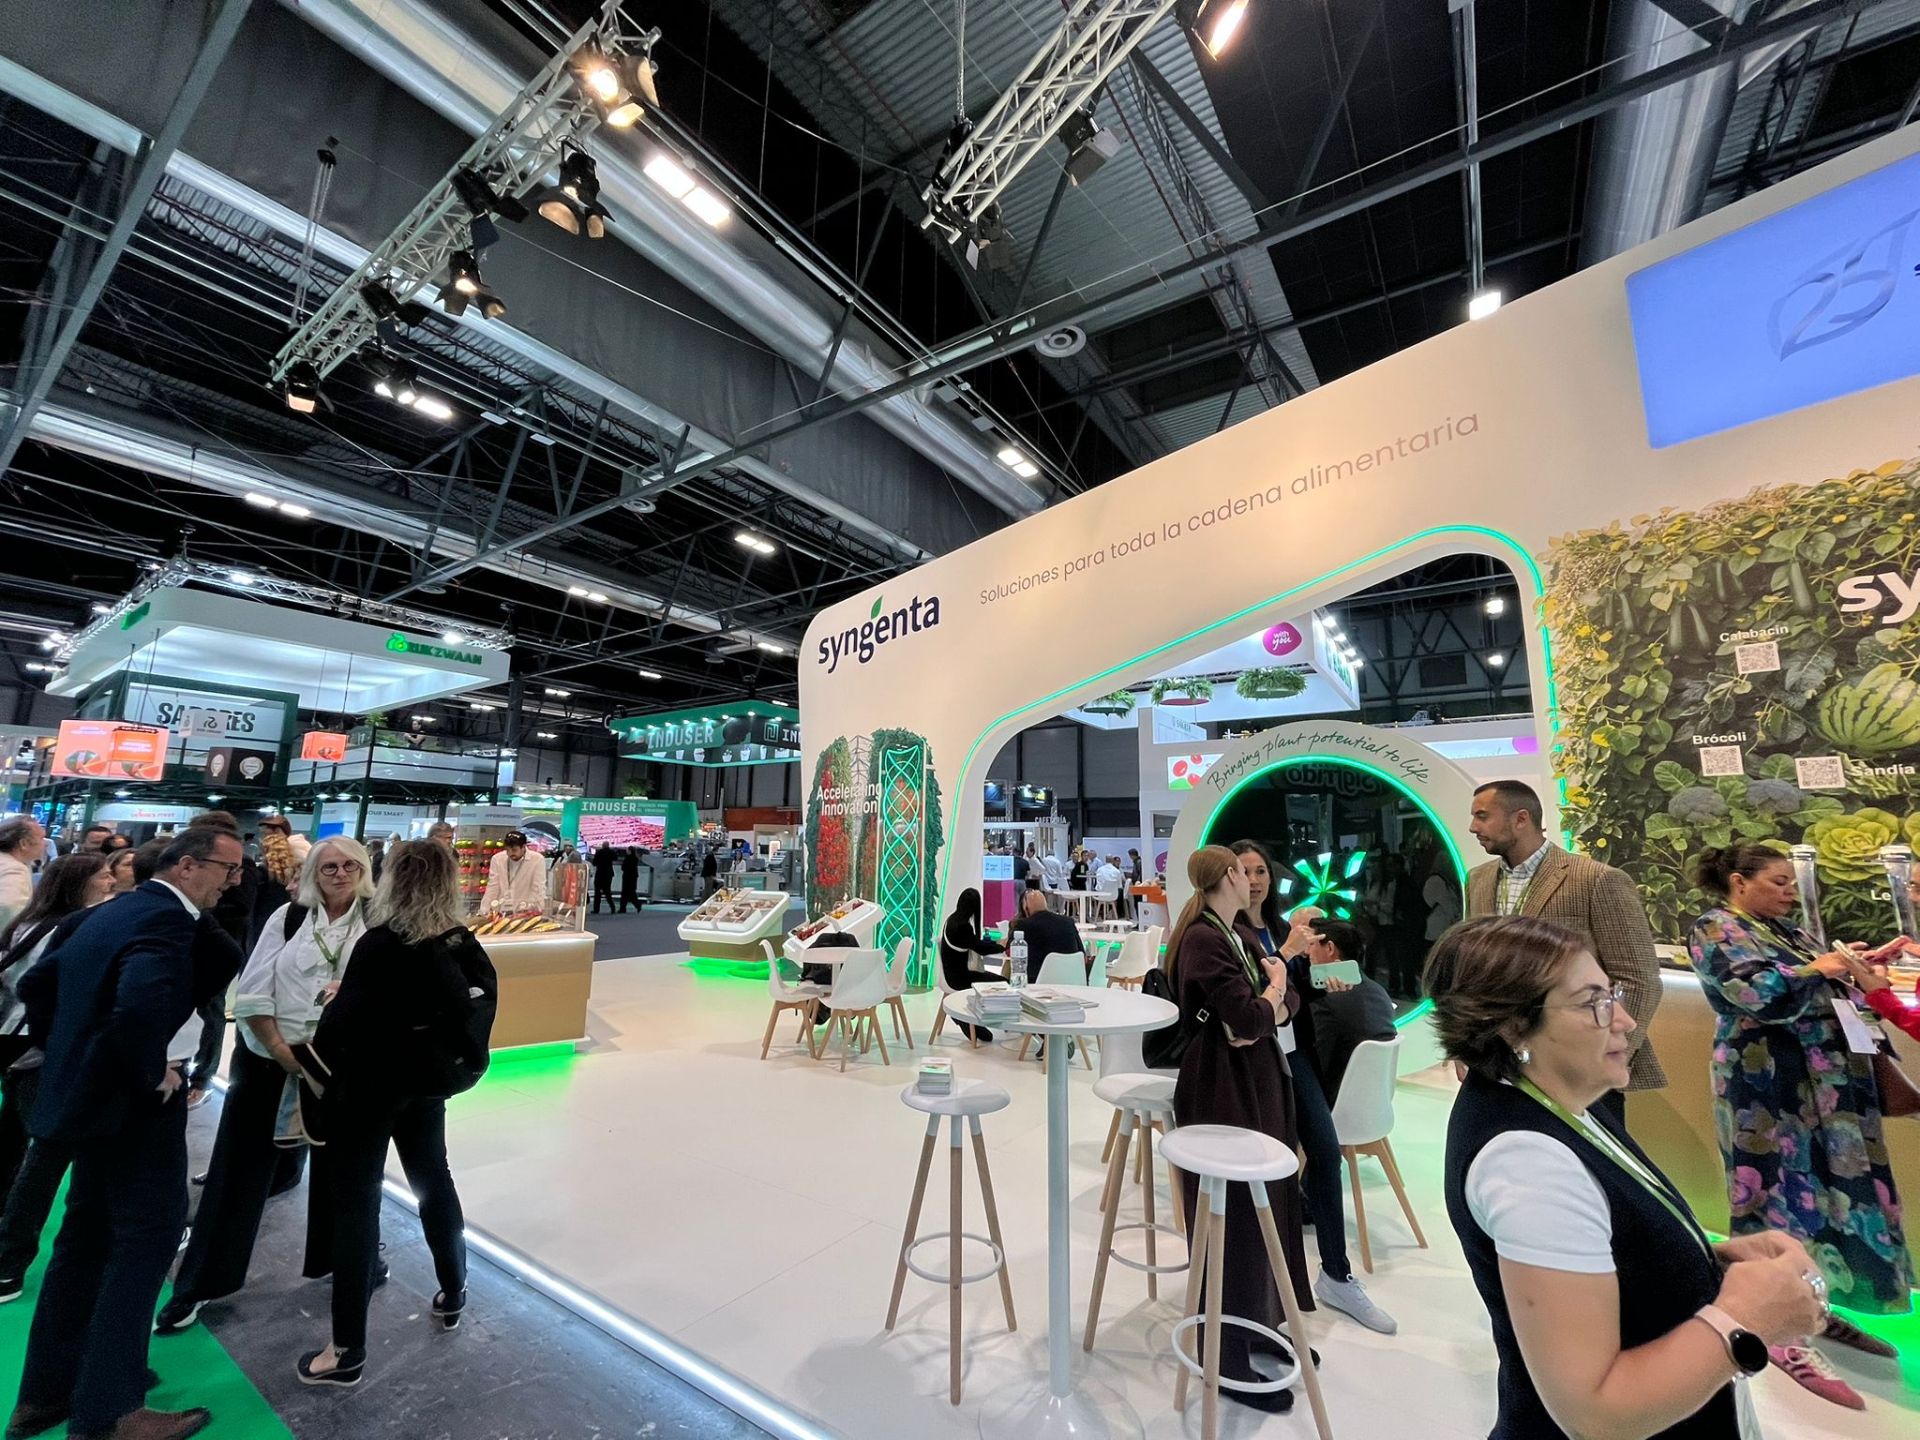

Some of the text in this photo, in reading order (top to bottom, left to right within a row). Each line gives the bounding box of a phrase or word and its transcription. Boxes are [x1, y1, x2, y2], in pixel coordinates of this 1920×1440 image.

[979, 413, 1480, 605] Soluciones para toda la cadena alimentaria
[818, 595, 940, 674] syngenta
[1273, 630, 1289, 639] with
[1719, 624, 1790, 643] Calabacín
[1272, 635, 1292, 651] you
[156, 702, 256, 733] SAES
[647, 724, 714, 750] INDUSER
[1692, 731, 1747, 745] Brócoli
[1206, 731, 1429, 793] Bringing plant potential to life
[1850, 763, 1916, 778] Sandía
[816, 783, 882, 801] Accelerating
[581, 801, 637, 812] INDUSER
[821, 800, 878, 817] Innovation
